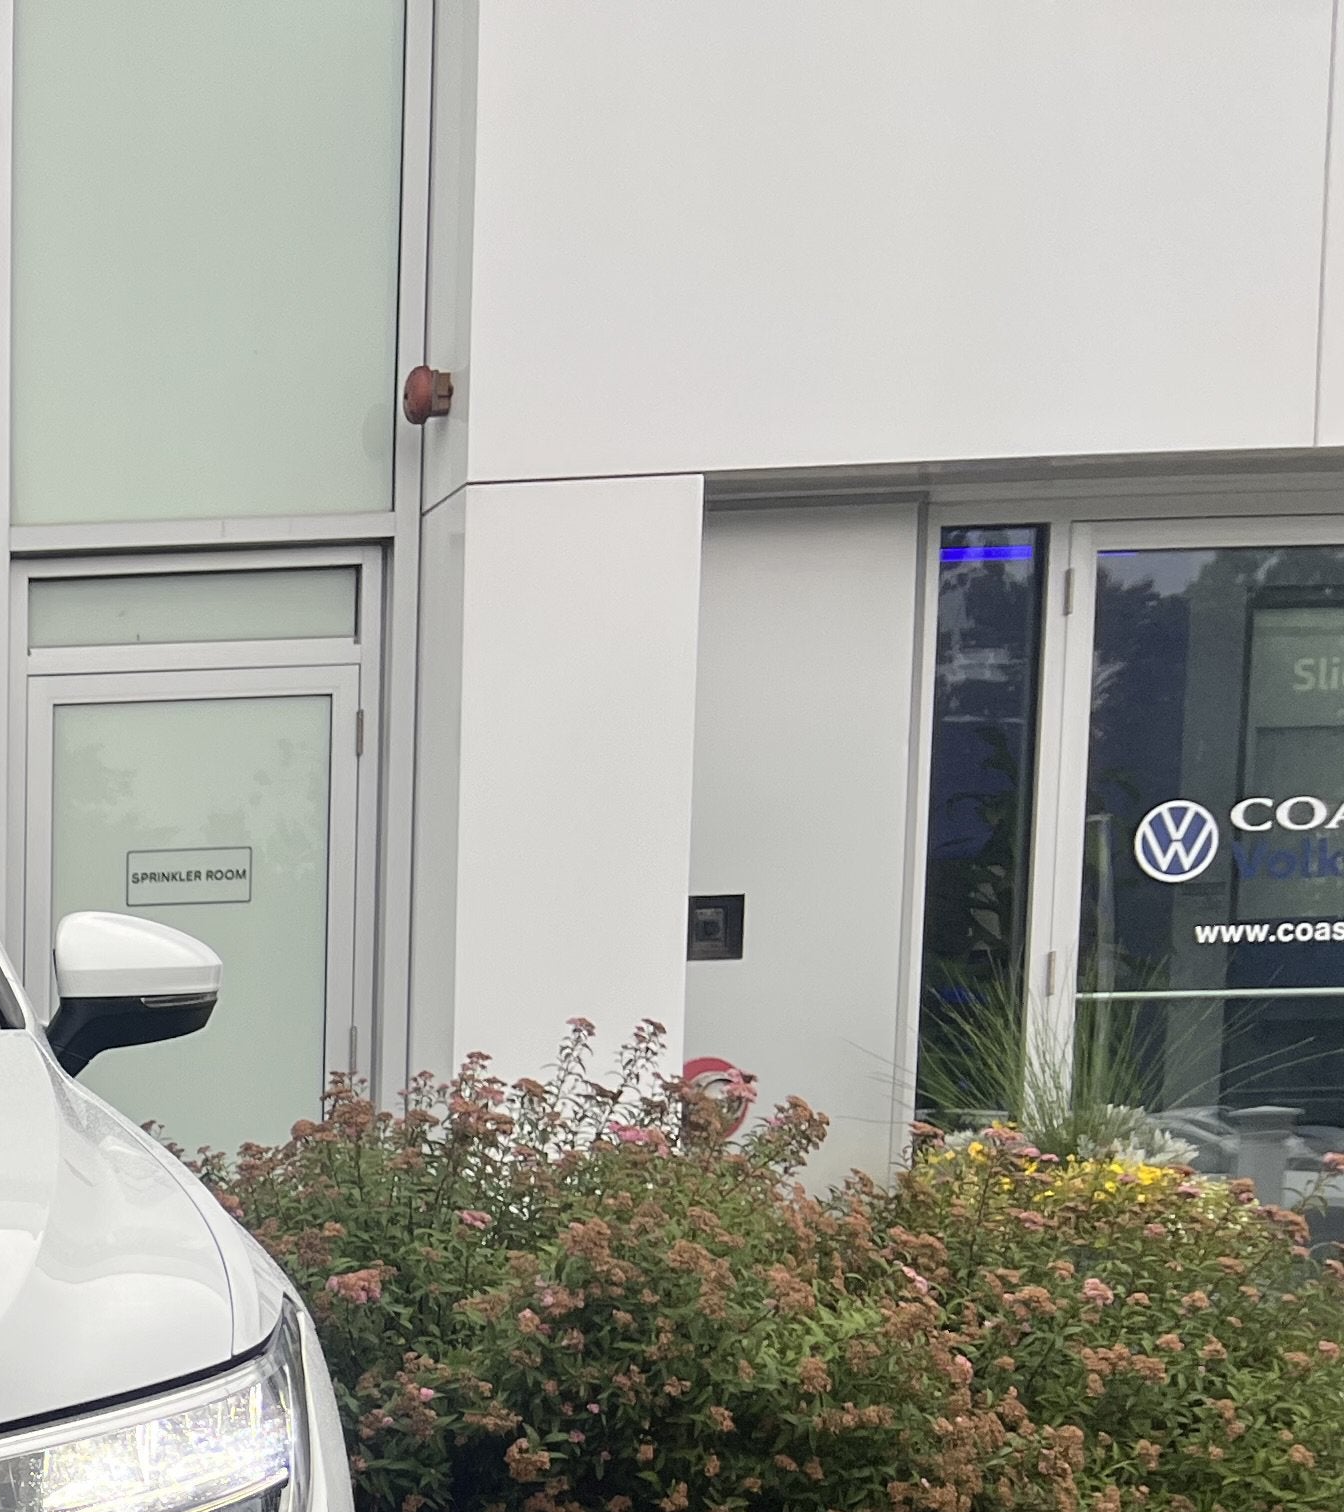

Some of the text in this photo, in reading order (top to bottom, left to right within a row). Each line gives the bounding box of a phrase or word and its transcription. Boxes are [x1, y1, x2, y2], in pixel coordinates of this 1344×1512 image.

[1293, 656, 1344, 691] Sli
[131, 869, 247, 885] SPRINKLER ROOM
[1194, 921, 1344, 943] www.coas
